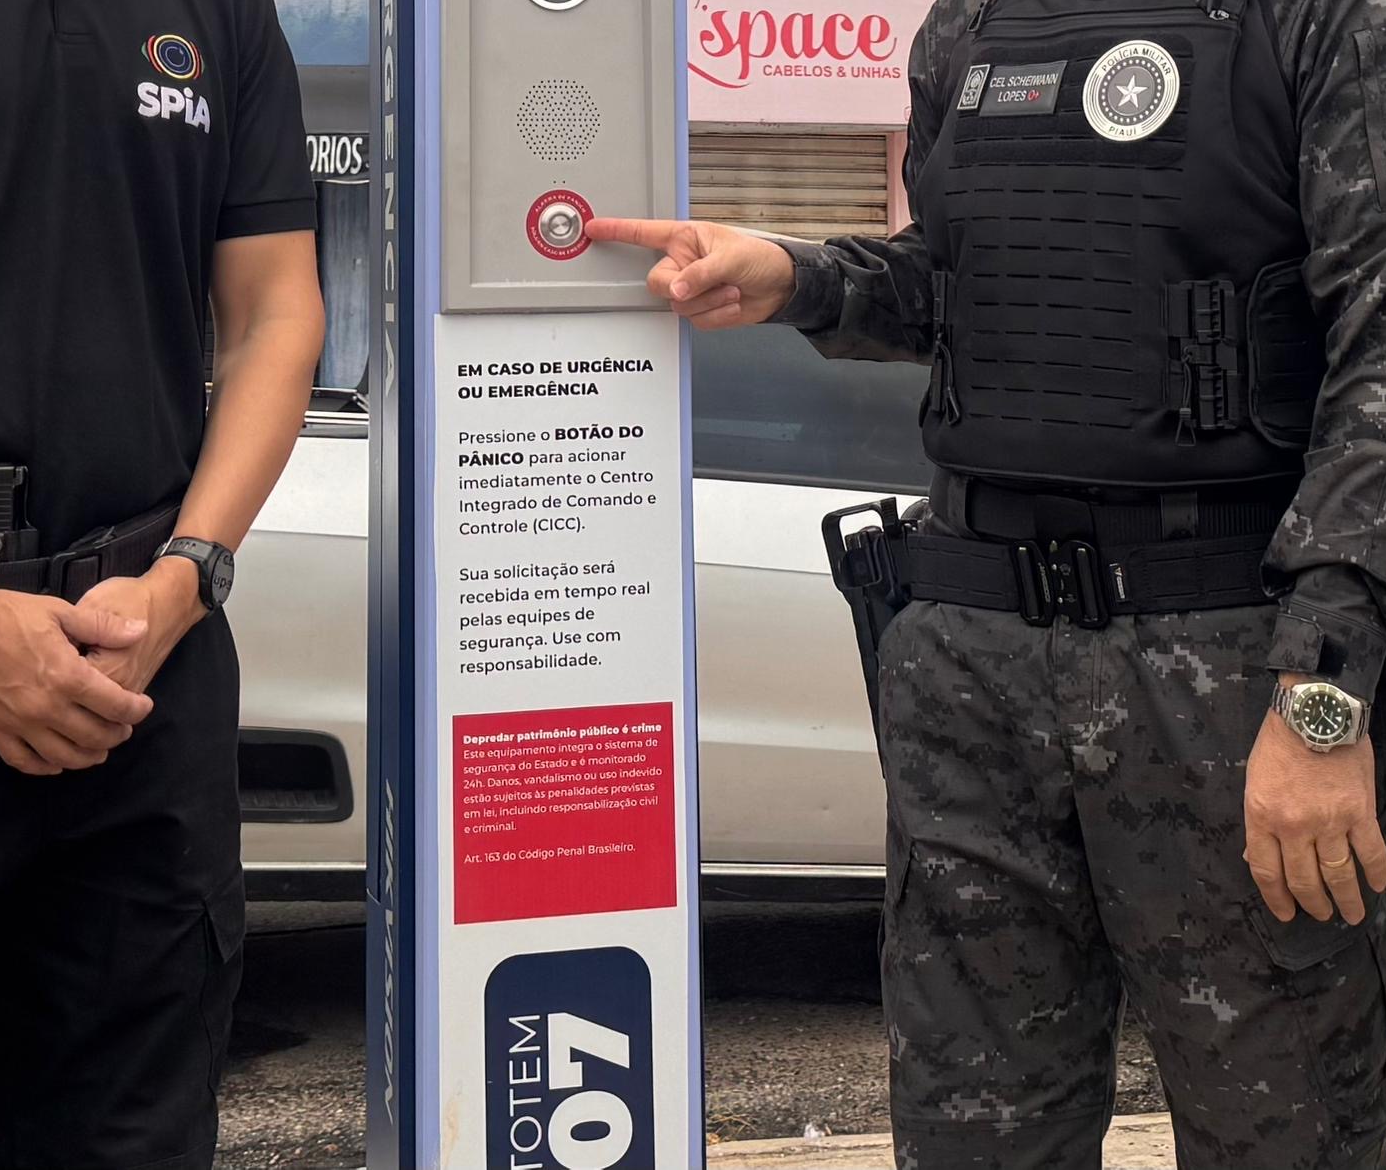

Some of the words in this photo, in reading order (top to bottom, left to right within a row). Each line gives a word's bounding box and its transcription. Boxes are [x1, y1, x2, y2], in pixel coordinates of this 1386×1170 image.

[763, 64, 833, 78] CABELOS
[836, 65, 847, 78] &
[851, 66, 902, 80] UNHAS
[1101, 47, 1140, 73] POLÍCIA
[1141, 47, 1172, 76] MILITAR
[997, 90, 1028, 103] LOPES
[1108, 125, 1138, 137] PIAUÍ
[458, 364, 483, 378] EM
[487, 362, 535, 376] CASO
[540, 361, 563, 375] DE
[567, 357, 654, 374] URGÊNCIA
[458, 386, 483, 400] OU
[487, 381, 599, 399] EMERGÊNCIA
[458, 429, 536, 445] Pressione
[540, 431, 550, 442] o
[554, 424, 615, 441] BOTÃO
[618, 426, 644, 439] DO
[458, 450, 525, 468] PÂNICO
[529, 452, 563, 466] para
[568, 449, 627, 463] acionar
[458, 472, 583, 490] imediatamente
[586, 474, 596, 484] o
[600, 470, 654, 484] Centro
[459, 497, 537, 514] Integrado
[542, 495, 562, 509] de
[566, 492, 643, 508] Comando
[647, 494, 657, 505] e
[459, 519, 528, 536] Controle
[533, 517, 585, 535] (CICC).
[459, 567, 489, 582] Sua
[493, 562, 579, 581] solicitação
[582, 560, 616, 575] será
[459, 587, 529, 605] recebida
[534, 589, 560, 601] em
[564, 584, 617, 600] tempo
[621, 581, 651, 596] real
[459, 612, 503, 631] pelas
[506, 608, 571, 627] equipes
[575, 607, 595, 621] de
[459, 636, 548, 652] segurança.
[552, 631, 582, 645] Use
[586, 630, 621, 643] com
[459, 653, 602, 676] responsabilidade.
[463, 733, 515, 746] Depredar
[517, 727, 577, 743] patrimônio
[579, 725, 620, 739] público
[621, 724, 629, 734] é
[631, 722, 662, 733] crime
[463, 749, 485, 759] Este
[487, 746, 556, 759] equipamento
[558, 742, 594, 754] integra
[595, 742, 603, 750] o
[604, 739, 643, 750] sistema
[645, 737, 658, 747] de
[463, 763, 516, 776] segurança
[518, 761, 532, 770] do
[534, 758, 569, 770] Estado
[579, 756, 586, 766] é
[588, 752, 647, 765] monitorado
[463, 779, 486, 790] 24h.
[487, 777, 522, 788] Danos,
[524, 772, 582, 785] vandalismo
[583, 772, 597, 781] ou
[599, 771, 618, 780] uso
[619, 766, 663, 778] indevido
[463, 793, 492, 805] estão
[493, 790, 532, 804] sujeitos
[534, 789, 546, 800] às
[548, 785, 609, 800] penalidades
[610, 782, 656, 796] previstas
[463, 810, 481, 819] em
[483, 807, 498, 818] lei,
[499, 804, 547, 817] incluindo
[548, 797, 638, 814] responsabilização
[639, 795, 659, 806] civil
[463, 826, 471, 834] e
[472, 821, 517, 834] criminal.
[463, 854, 483, 864] Art.
[484, 851, 501, 862] 163
[502, 850, 517, 861] do
[518, 848, 555, 861] Código
[557, 845, 586, 857] Penal
[588, 842, 636, 855] Brasileiro.
[384, 778, 396, 1127] HIKVISION
[508, 1014, 543, 1170] TOTEM
[547, 1012, 633, 1170] 07
